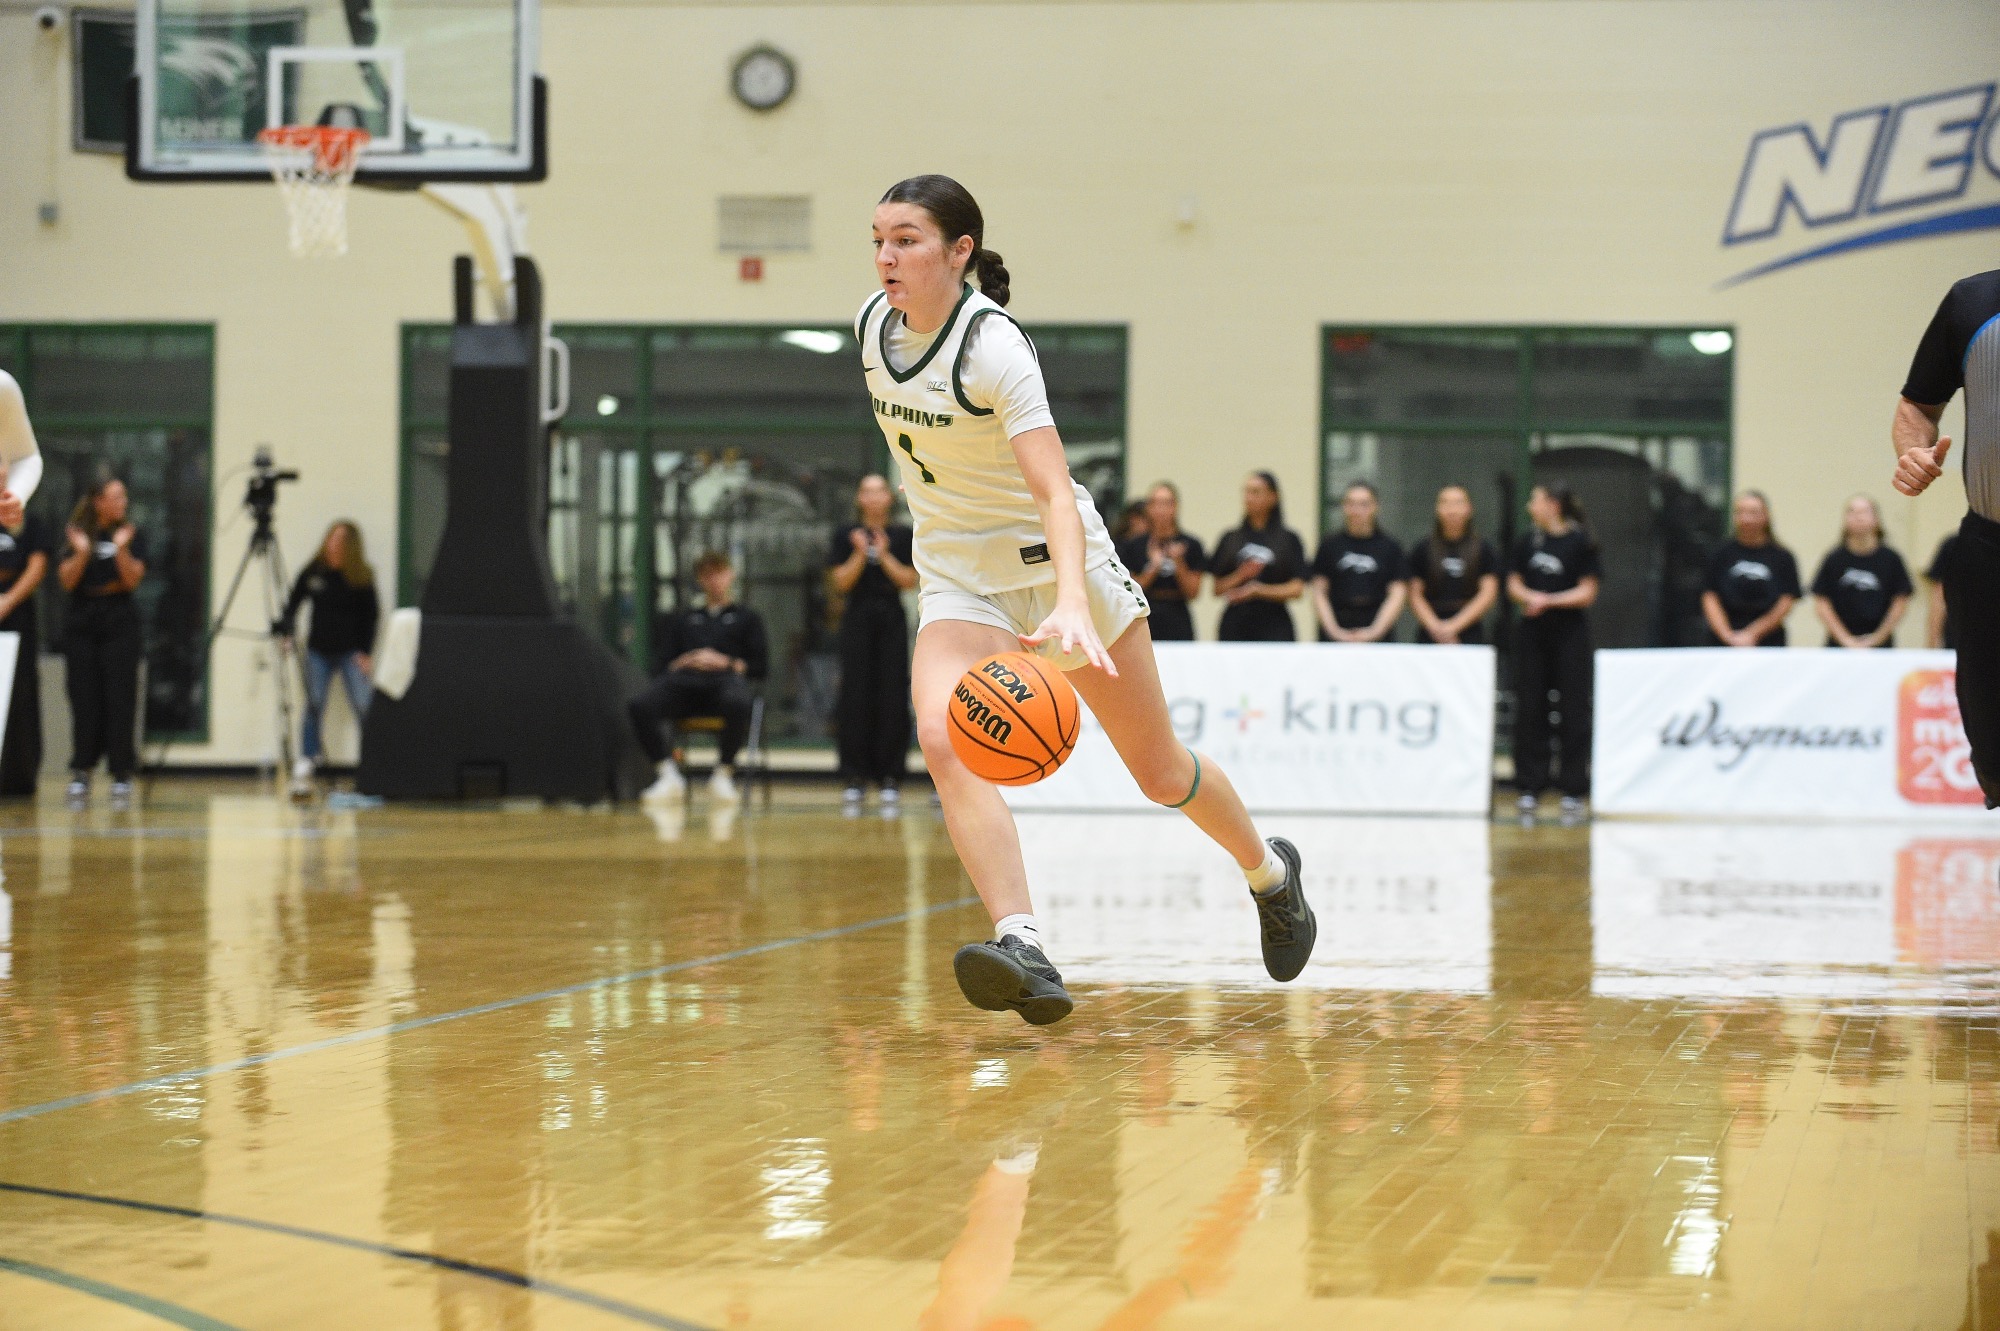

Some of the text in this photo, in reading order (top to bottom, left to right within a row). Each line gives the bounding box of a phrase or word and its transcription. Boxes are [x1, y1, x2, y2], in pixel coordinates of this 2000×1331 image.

[1721, 81, 2000, 247] NE
[898, 432, 936, 483] 1
[954, 681, 1013, 746] Wilson
[982, 660, 1035, 704] NCAA
[1281, 684, 1442, 749] king
[1660, 697, 1883, 772] Wegmans
